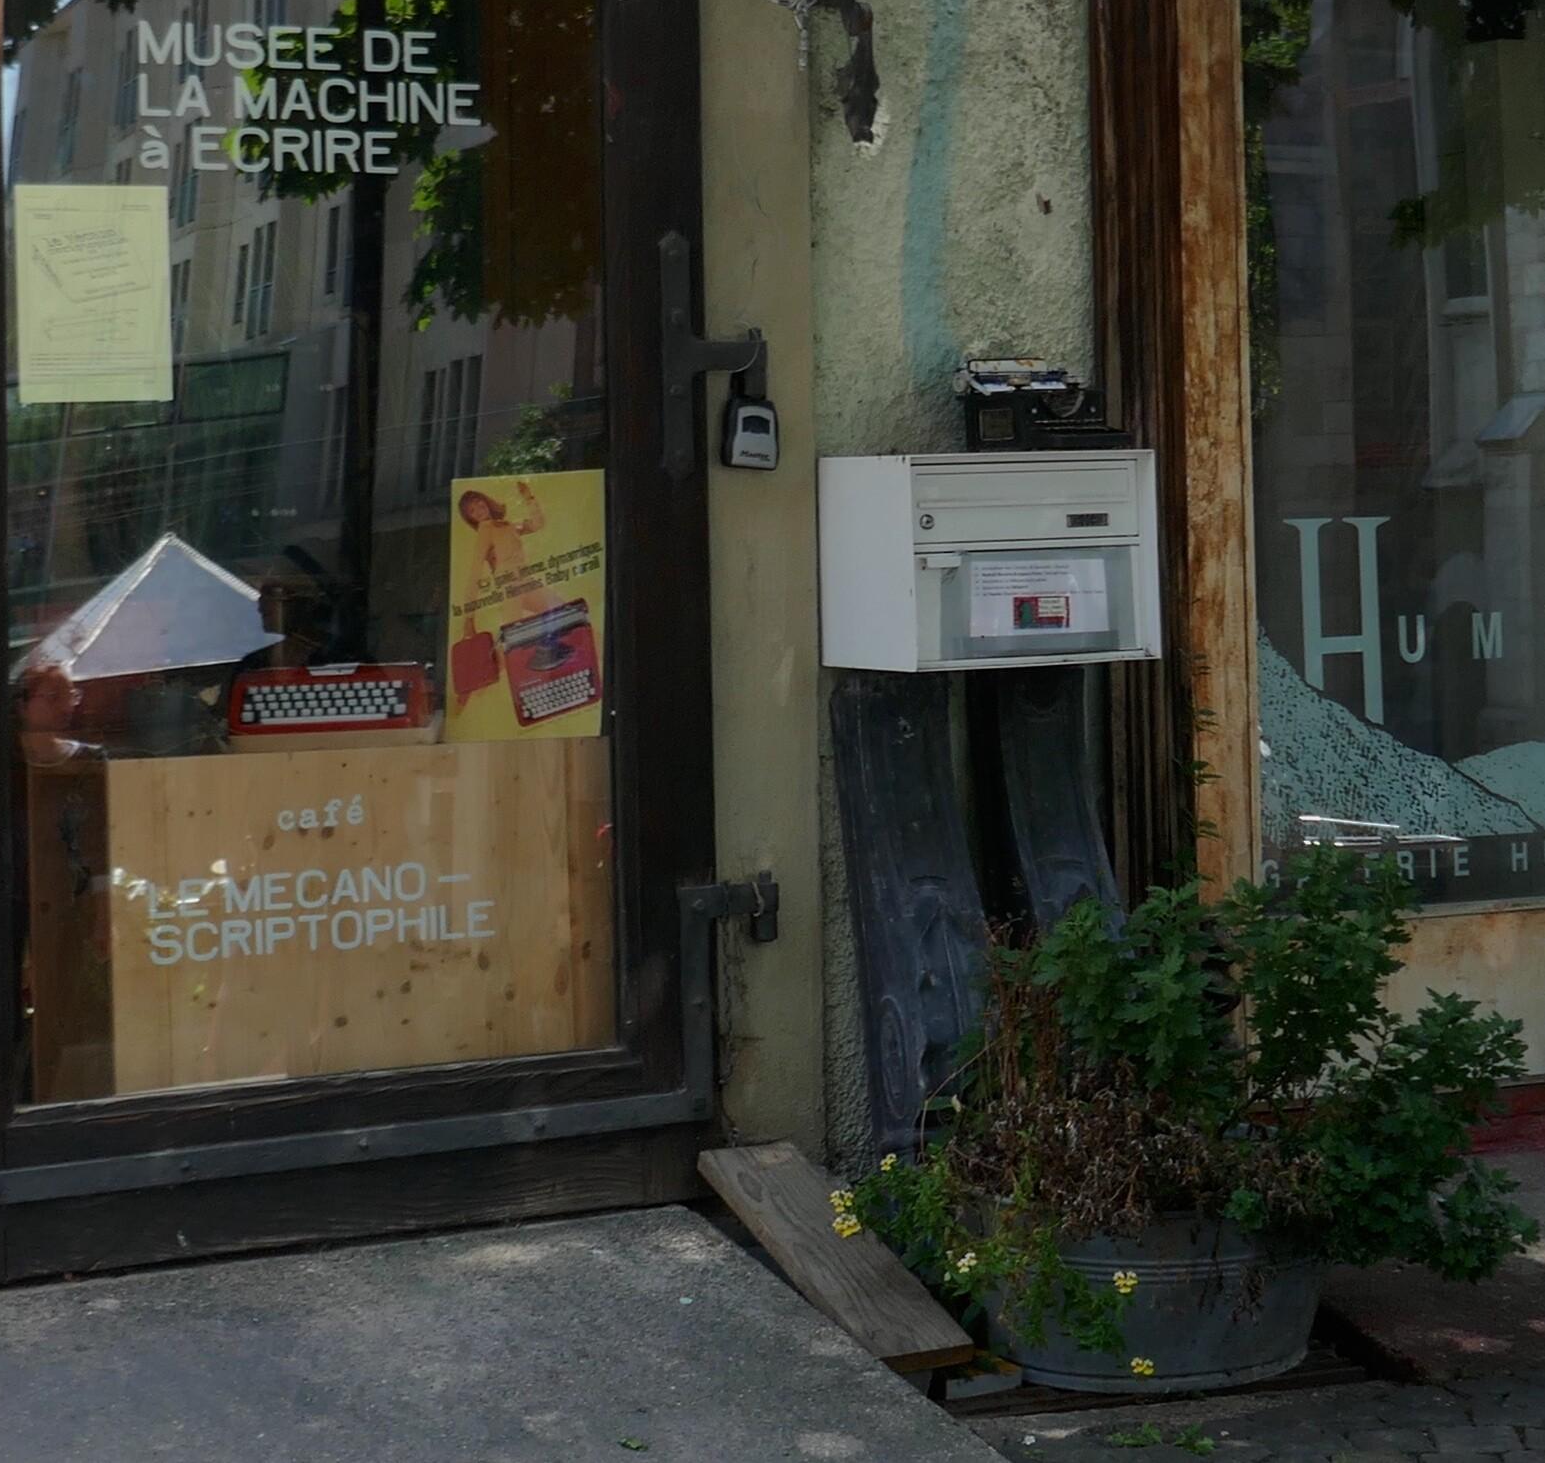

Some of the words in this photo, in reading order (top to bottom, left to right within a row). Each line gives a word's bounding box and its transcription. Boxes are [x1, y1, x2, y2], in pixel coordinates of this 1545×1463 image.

[137, 20, 341, 72] MUSEE
[363, 29, 438, 75] DE
[138, 73, 211, 118] LA
[233, 77, 482, 127] MACHINE
[139, 126, 170, 170] à
[192, 126, 400, 175] ECRIRE
[276, 793, 365, 831] café
[146, 878, 210, 920] LE
[148, 899, 498, 966] SCRIPTOPHILE
